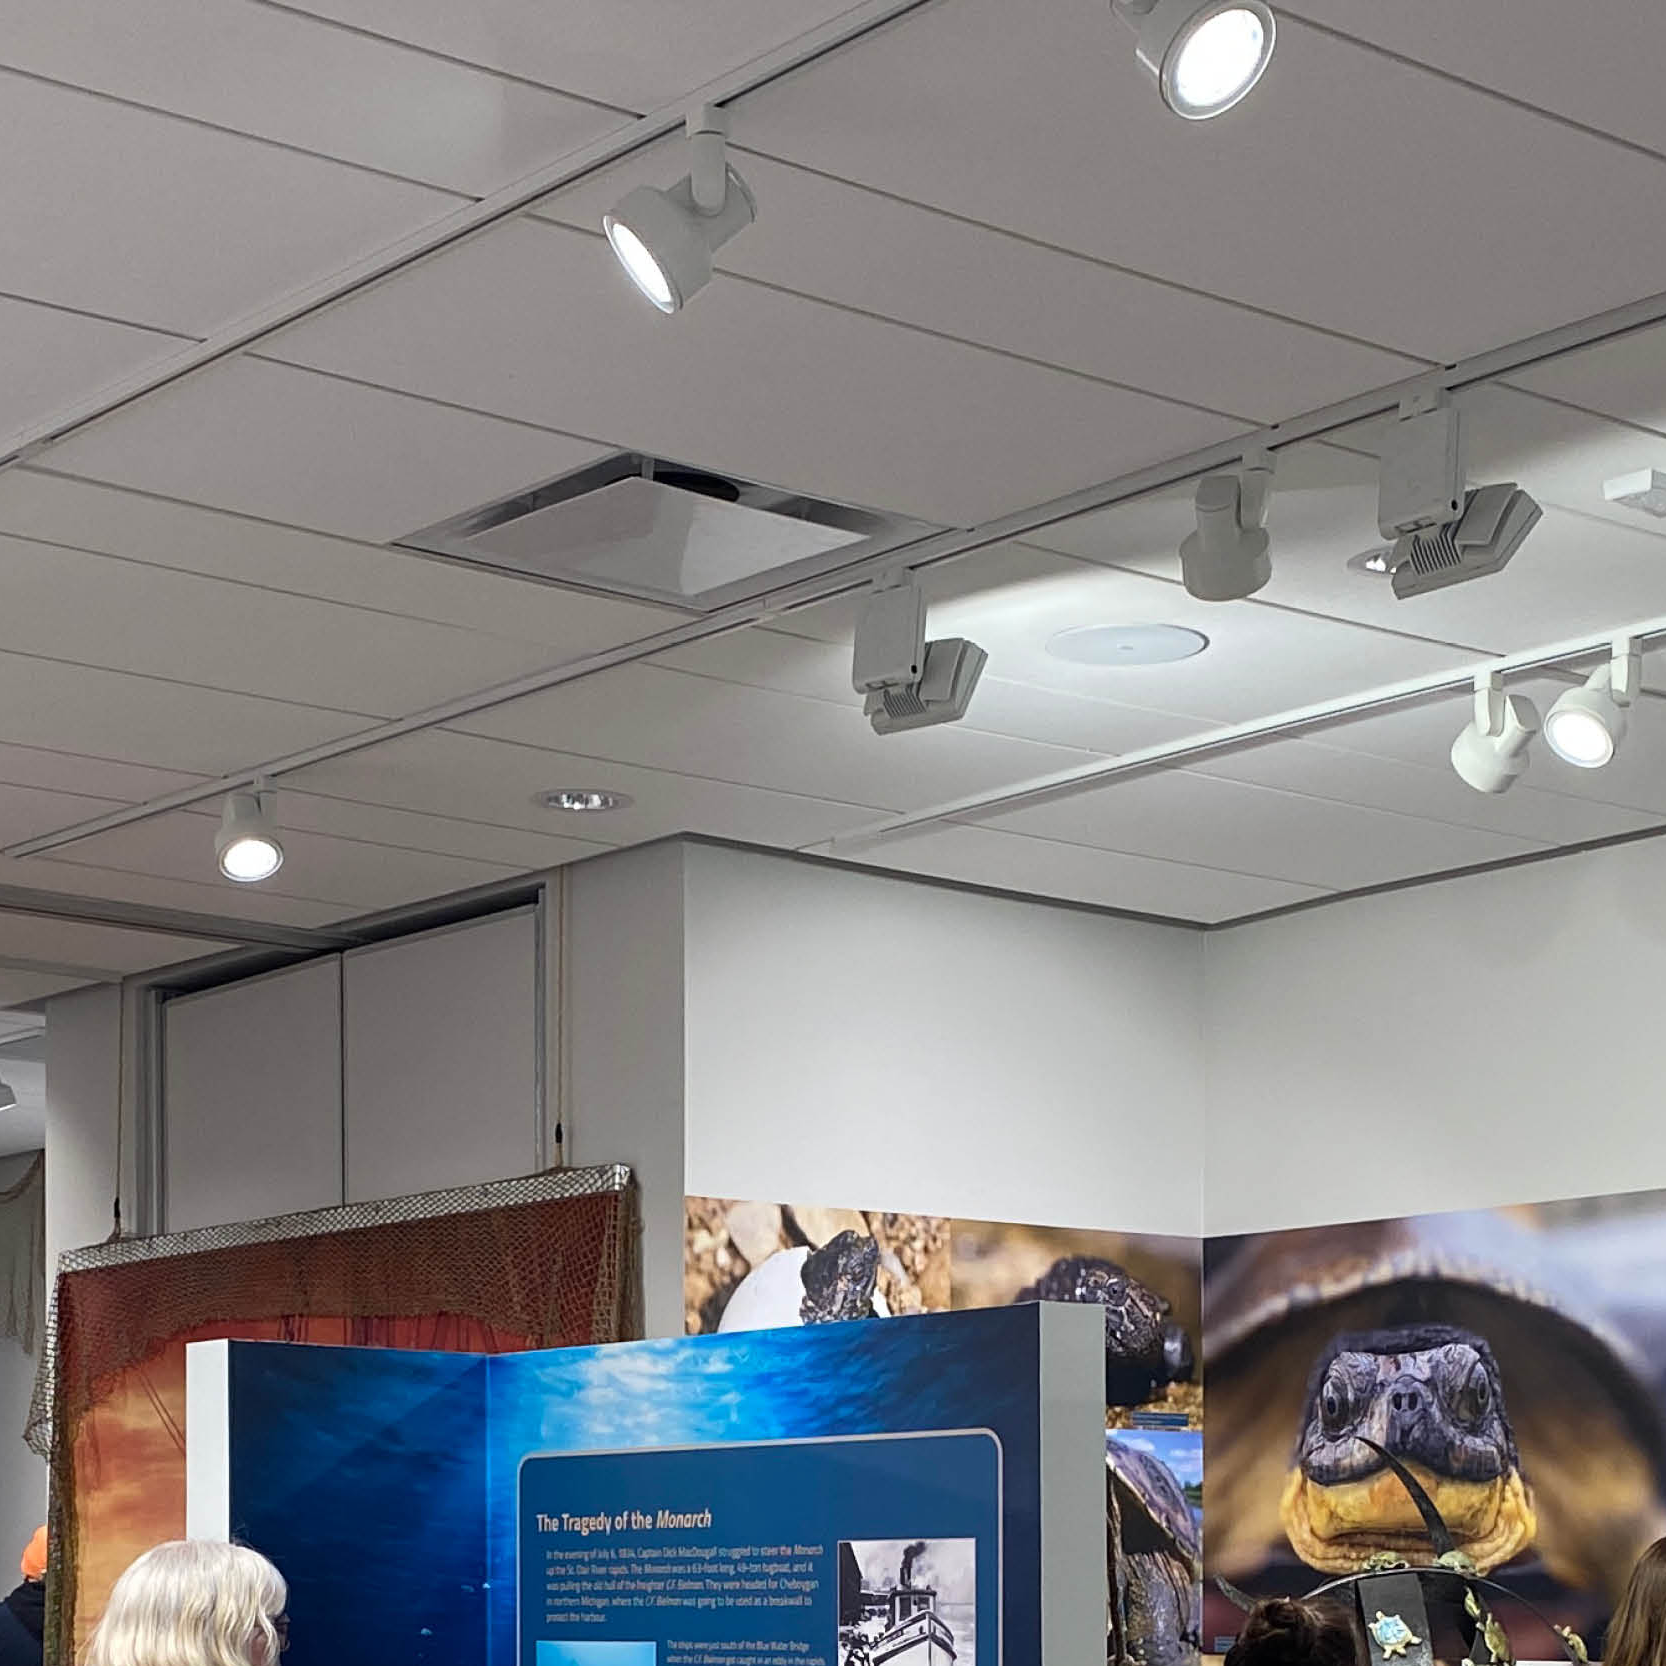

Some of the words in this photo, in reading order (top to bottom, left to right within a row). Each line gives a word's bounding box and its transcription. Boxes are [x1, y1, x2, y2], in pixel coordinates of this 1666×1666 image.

[537, 1514, 560, 1532] The
[562, 1513, 612, 1536] Tragedy
[614, 1511, 629, 1530] of
[630, 1512, 653, 1530] the
[656, 1508, 712, 1529] Monarch
